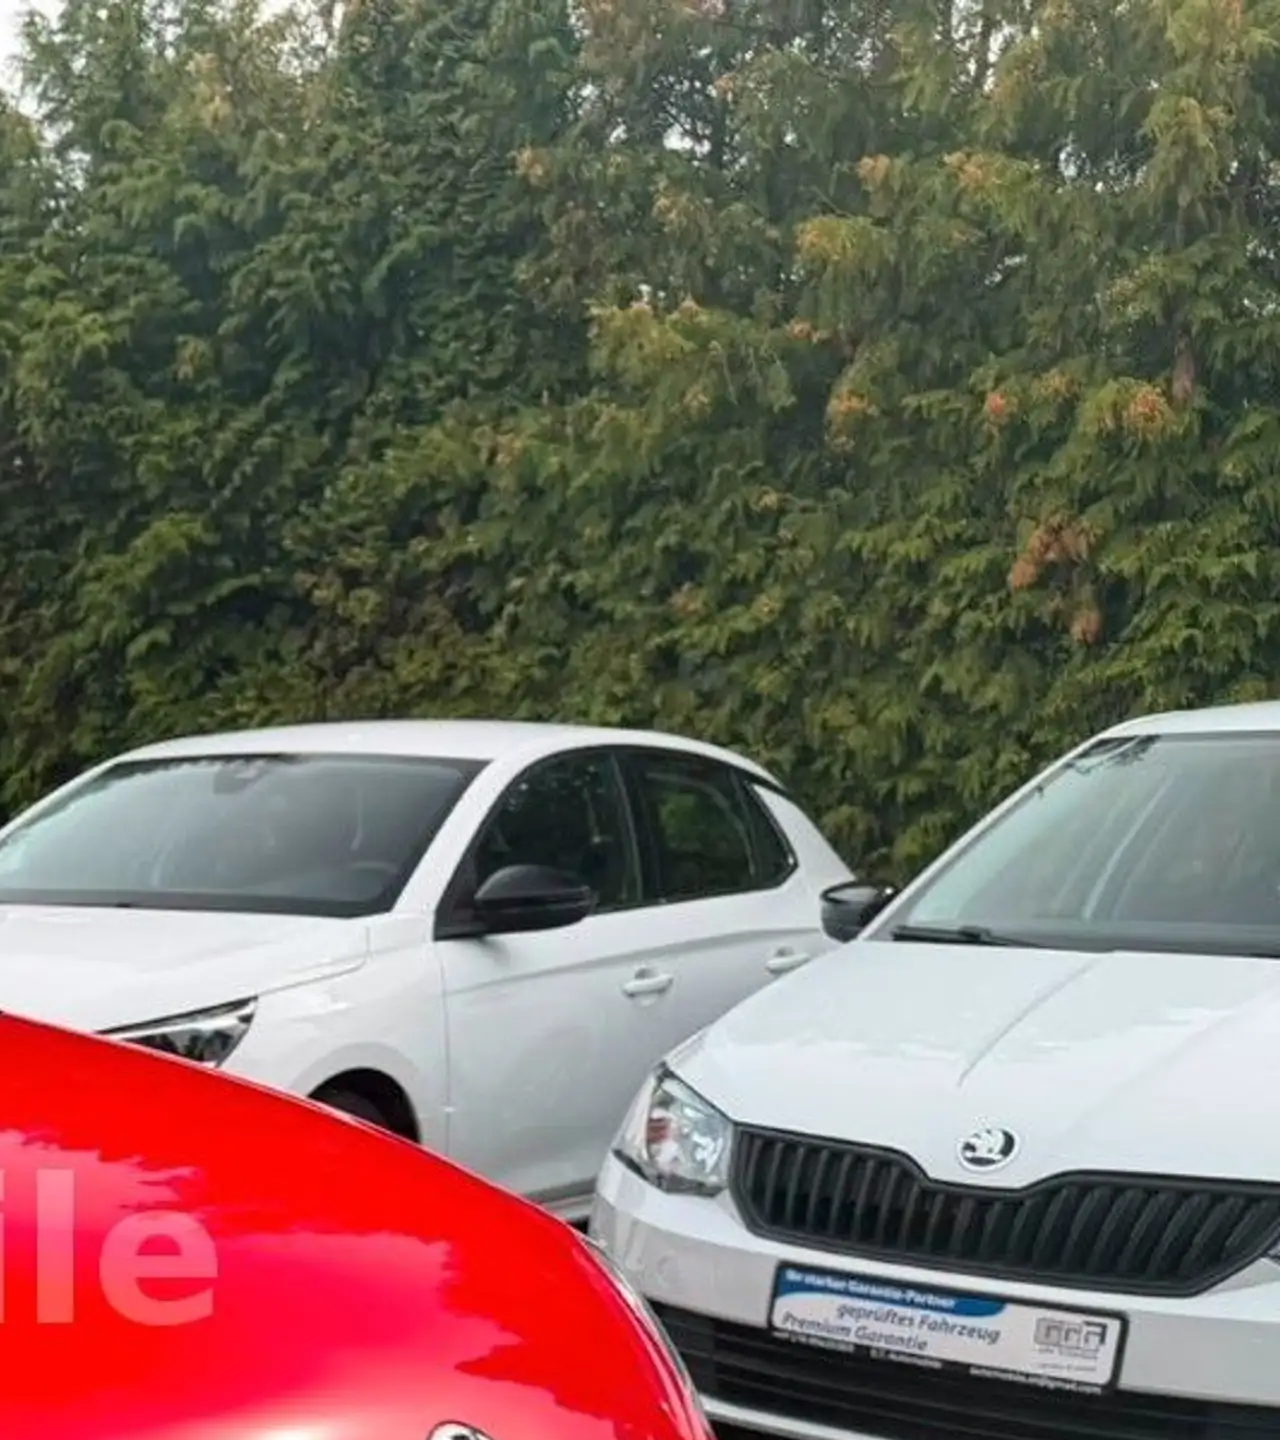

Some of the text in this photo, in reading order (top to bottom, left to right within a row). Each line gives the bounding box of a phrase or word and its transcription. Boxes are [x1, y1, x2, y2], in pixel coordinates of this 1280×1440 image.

[783, 1311, 852, 1338] Premium
[854, 1325, 929, 1351] Garantie
[837, 1304, 1001, 1345] geprüftes Fahrzeug
